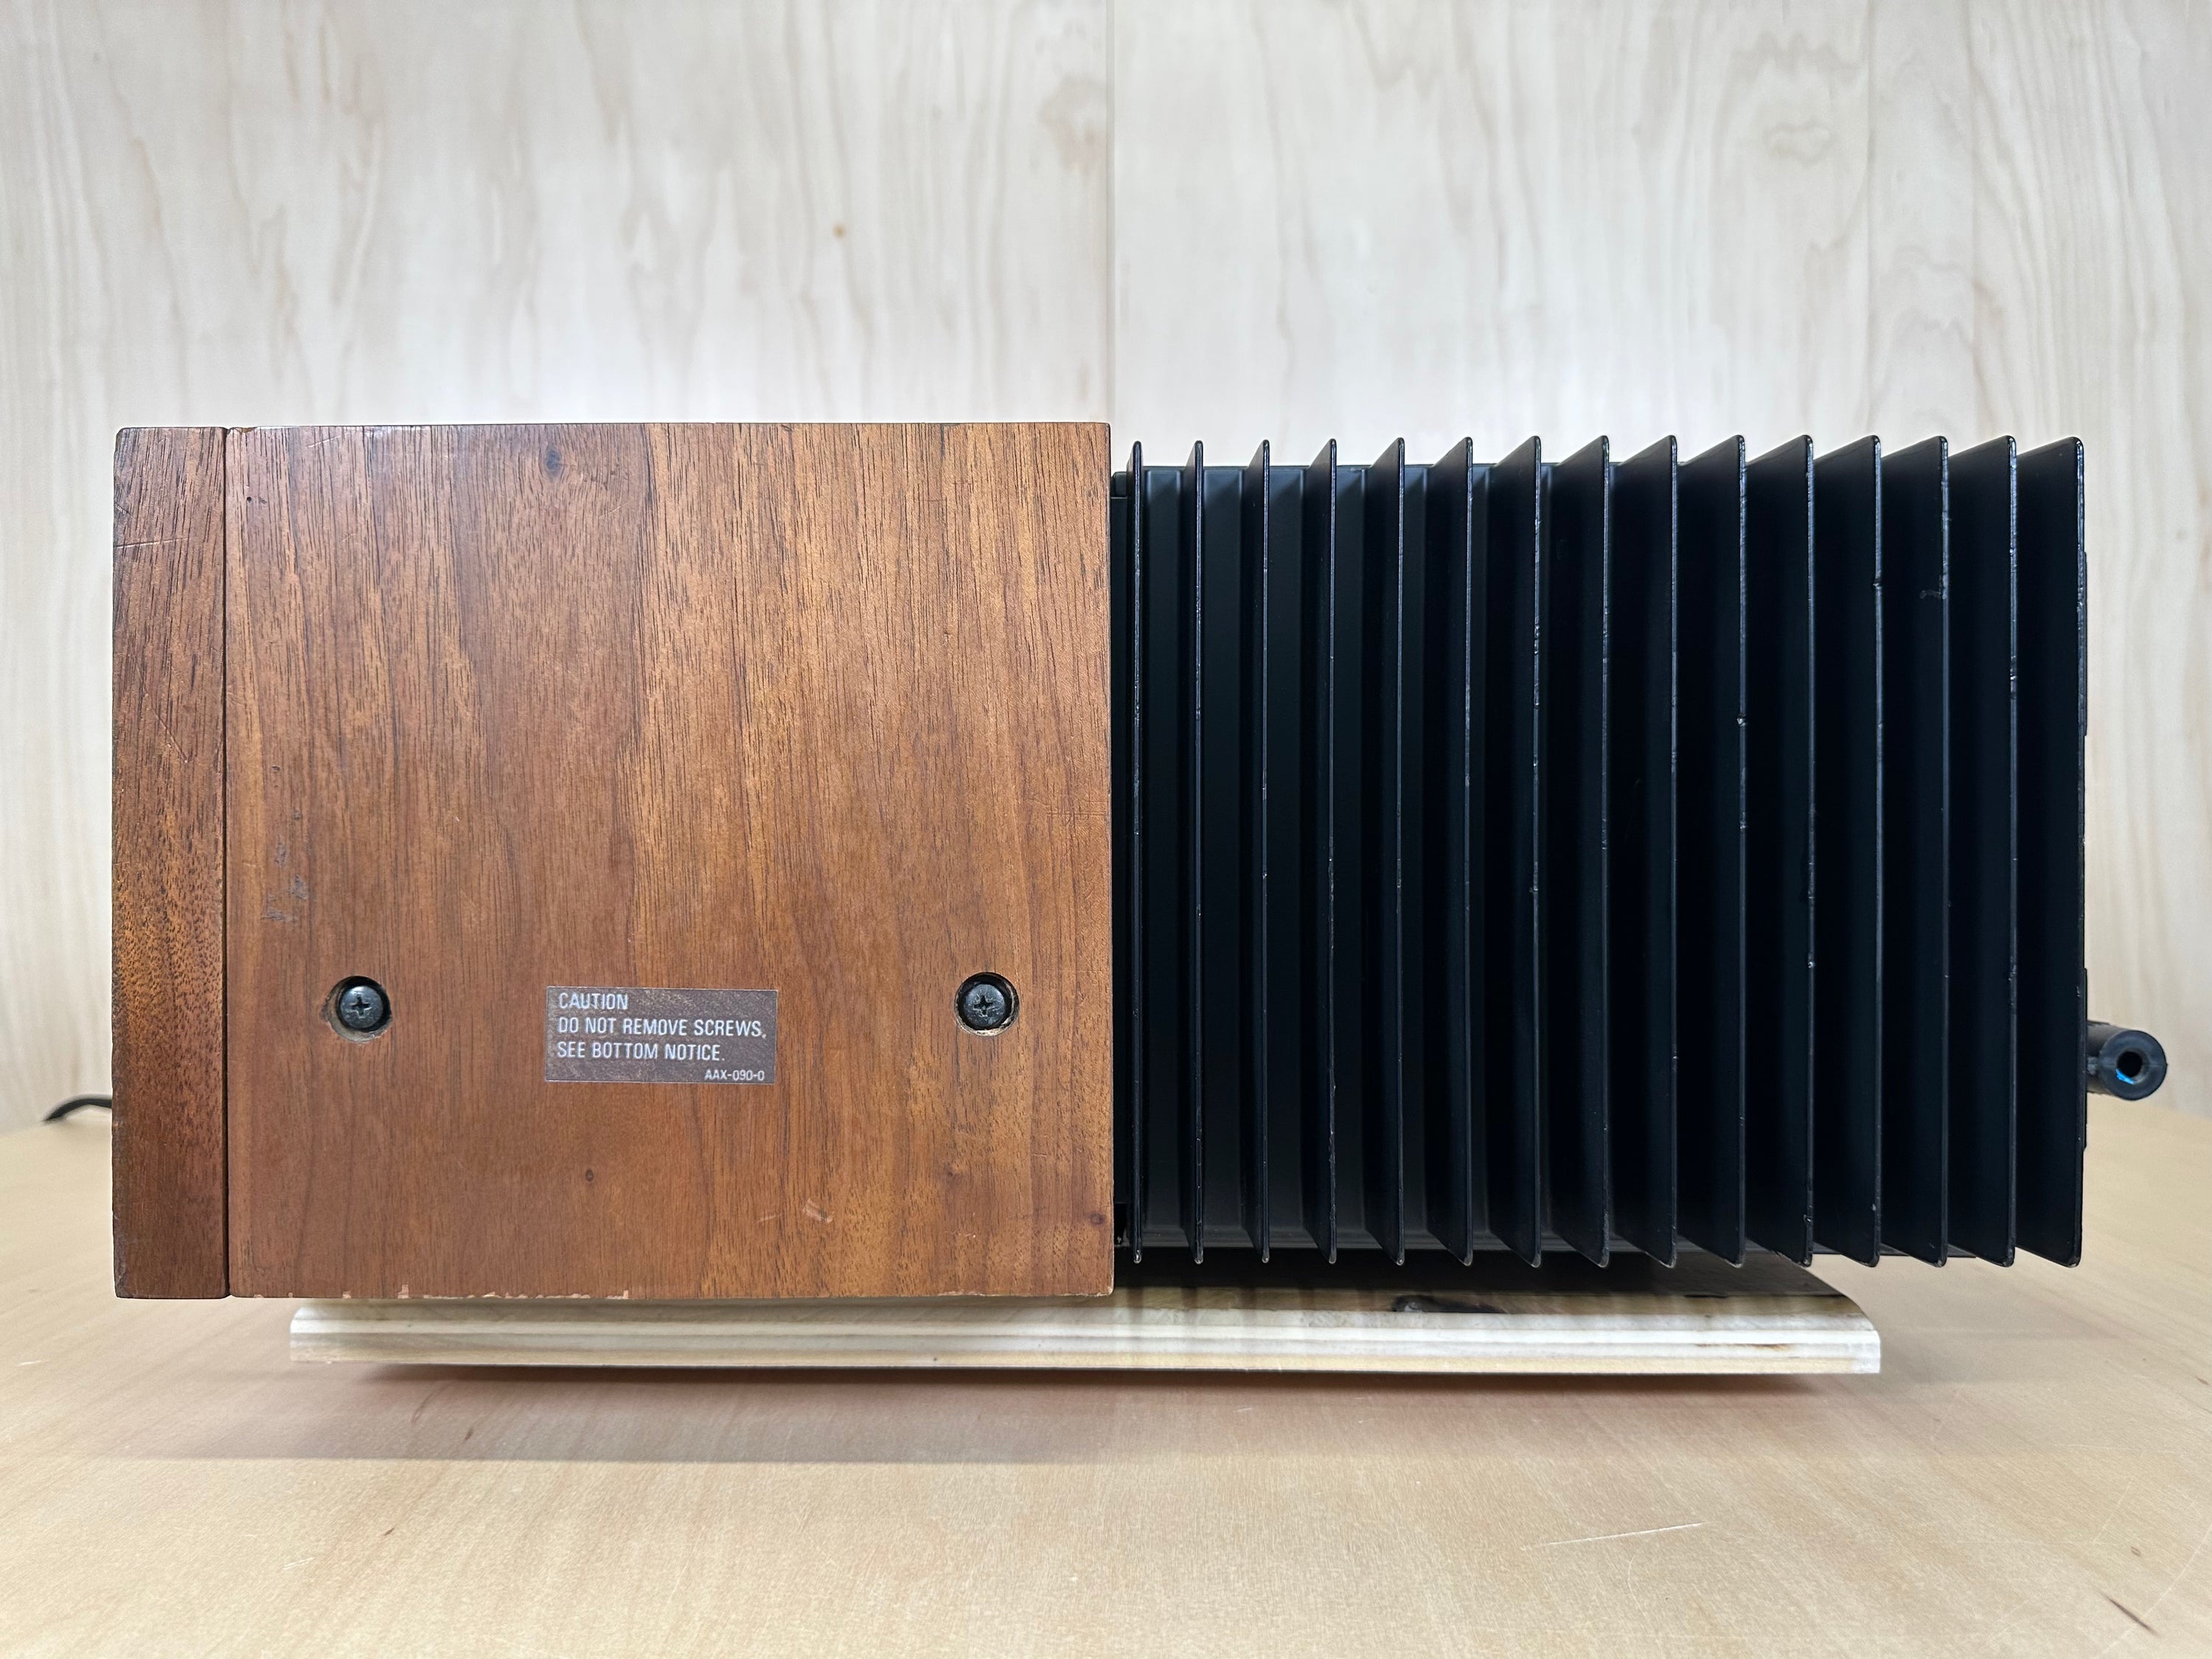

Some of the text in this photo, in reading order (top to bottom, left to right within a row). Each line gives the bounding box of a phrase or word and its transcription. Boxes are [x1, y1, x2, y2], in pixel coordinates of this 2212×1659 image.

[558, 992, 628, 1009] CAUTION
[558, 1017, 768, 1039] DO NOT REMOVE SCREWS.
[557, 1041, 726, 1061] SEE BOTTOM NOTICE.
